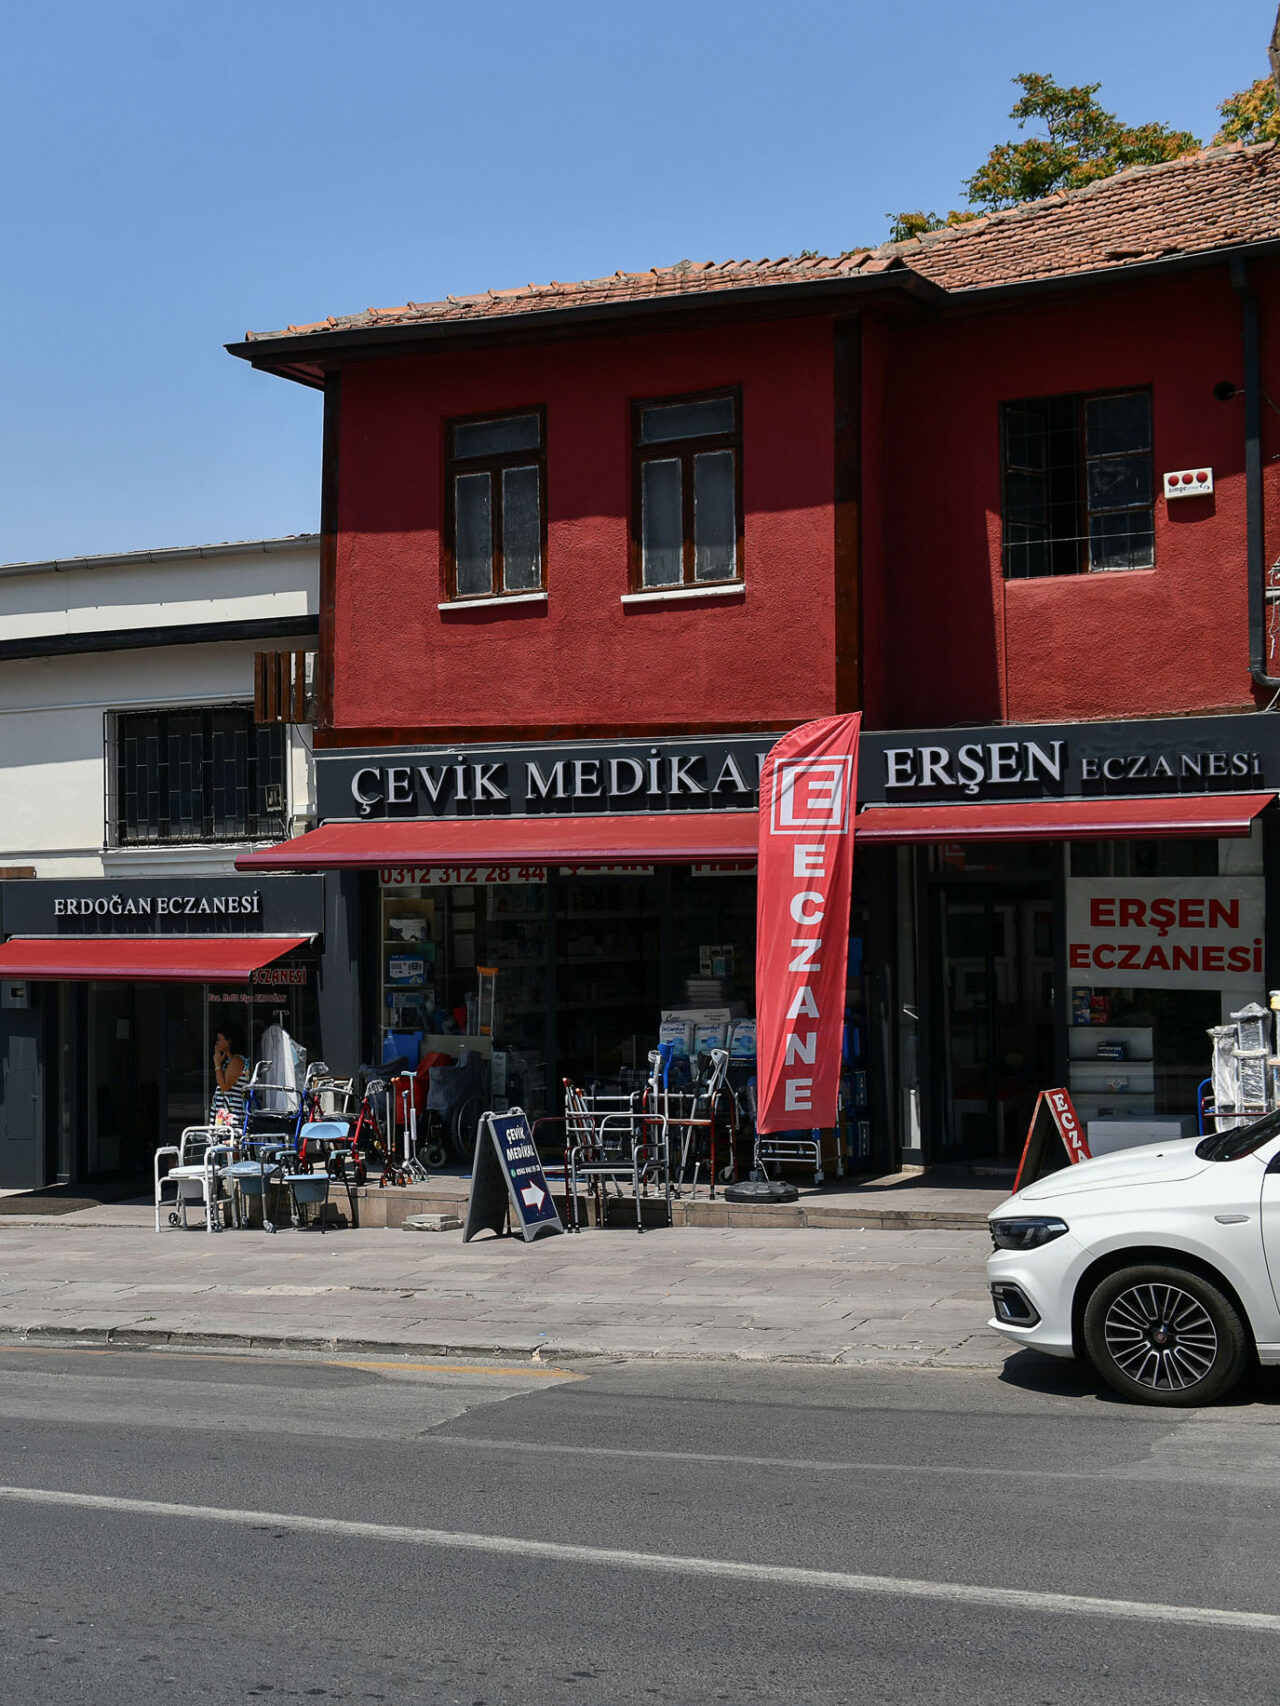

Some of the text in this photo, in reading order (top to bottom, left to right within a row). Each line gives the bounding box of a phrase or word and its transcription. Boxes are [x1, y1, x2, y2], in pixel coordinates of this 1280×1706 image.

[351, 754, 509, 815] ÇEVİK
[883, 740, 1064, 794] ERŞEN
[380, 866, 545, 884] 0312 312 28 44
[54, 890, 259, 915] ERDOĞAN ECZANESİ
[1090, 898, 1239, 937] ERŞEN
[1069, 937, 1263, 972] ECZANESİ
[784, 843, 826, 1112] ECZANE
[506, 1124, 526, 1145] ÇEVİK
[506, 1143, 535, 1161] MEDİKAL
